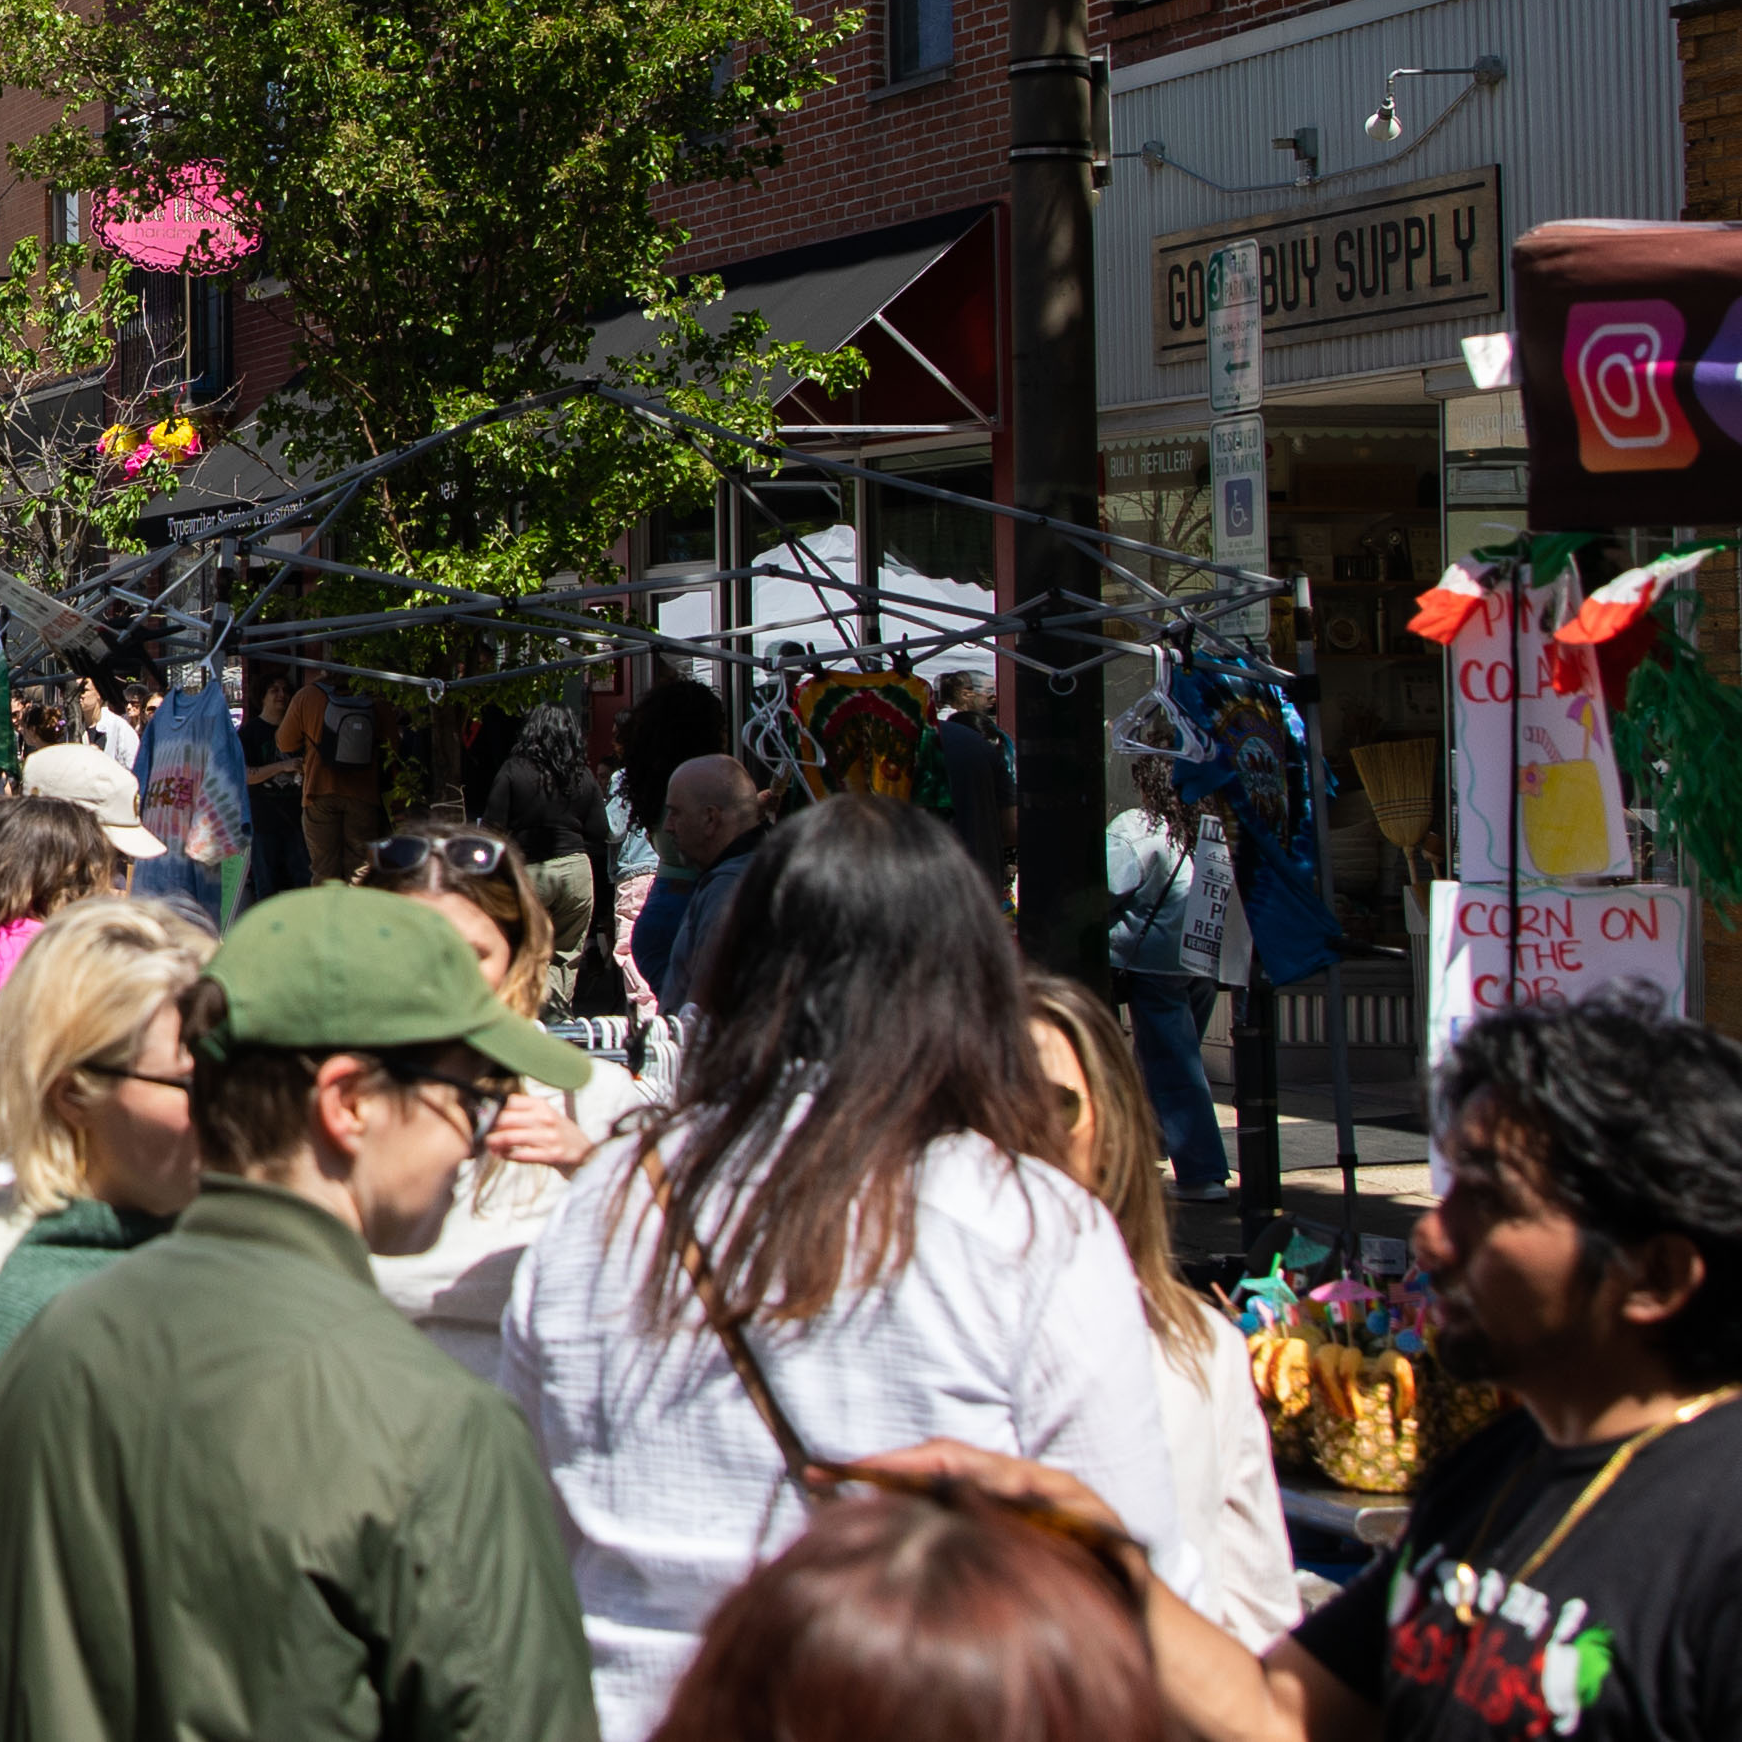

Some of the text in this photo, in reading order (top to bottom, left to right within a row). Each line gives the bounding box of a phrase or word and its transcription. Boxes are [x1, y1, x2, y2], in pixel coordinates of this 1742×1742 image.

[1168, 205, 1476, 331] GO BUY SUPPLY
[1110, 449, 1194, 478] BULK REFILLERY
[167, 513, 216, 541] Typewriter
[1458, 896, 1659, 942] CORN ON
[1506, 940, 1583, 972] THE
